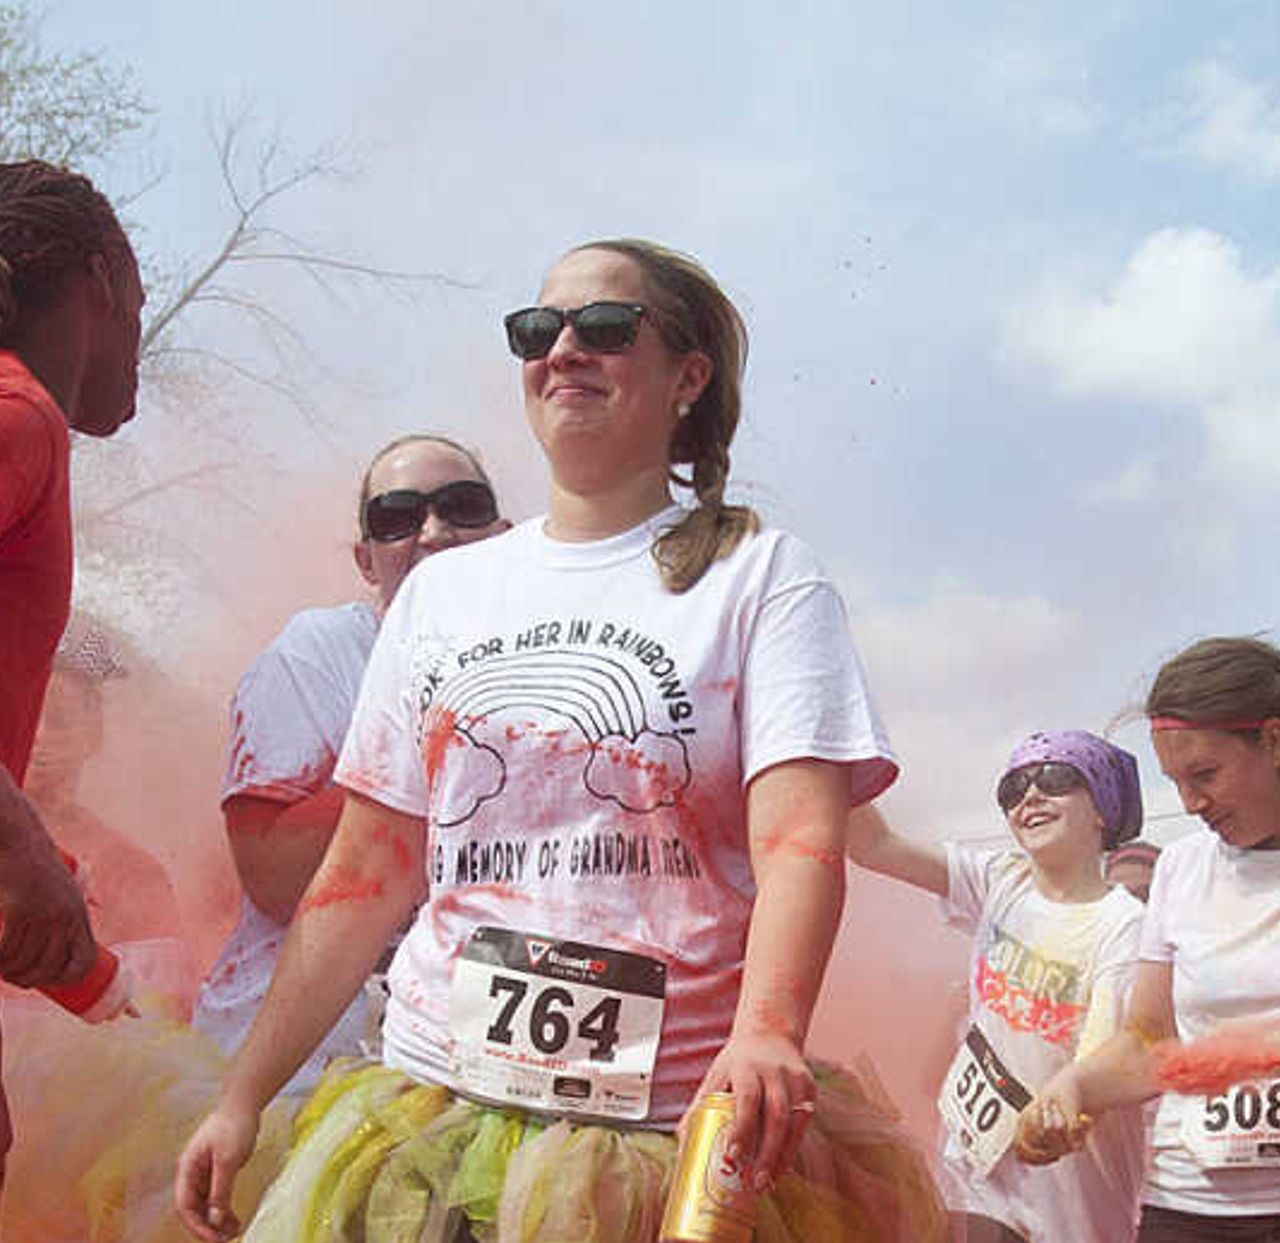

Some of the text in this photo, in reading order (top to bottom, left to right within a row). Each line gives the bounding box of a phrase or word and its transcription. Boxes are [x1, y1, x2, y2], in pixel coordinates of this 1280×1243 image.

[456, 638, 504, 669] FOR
[515, 621, 562, 652] HER
[569, 618, 593, 645] IN
[597, 622, 697, 736] RAINBOWS!
[455, 841, 527, 884] MEMORY
[538, 839, 561, 878] OF
[570, 832, 652, 877] GRANDMA
[486, 974, 621, 1063] 764
[956, 1062, 1001, 1133] 510
